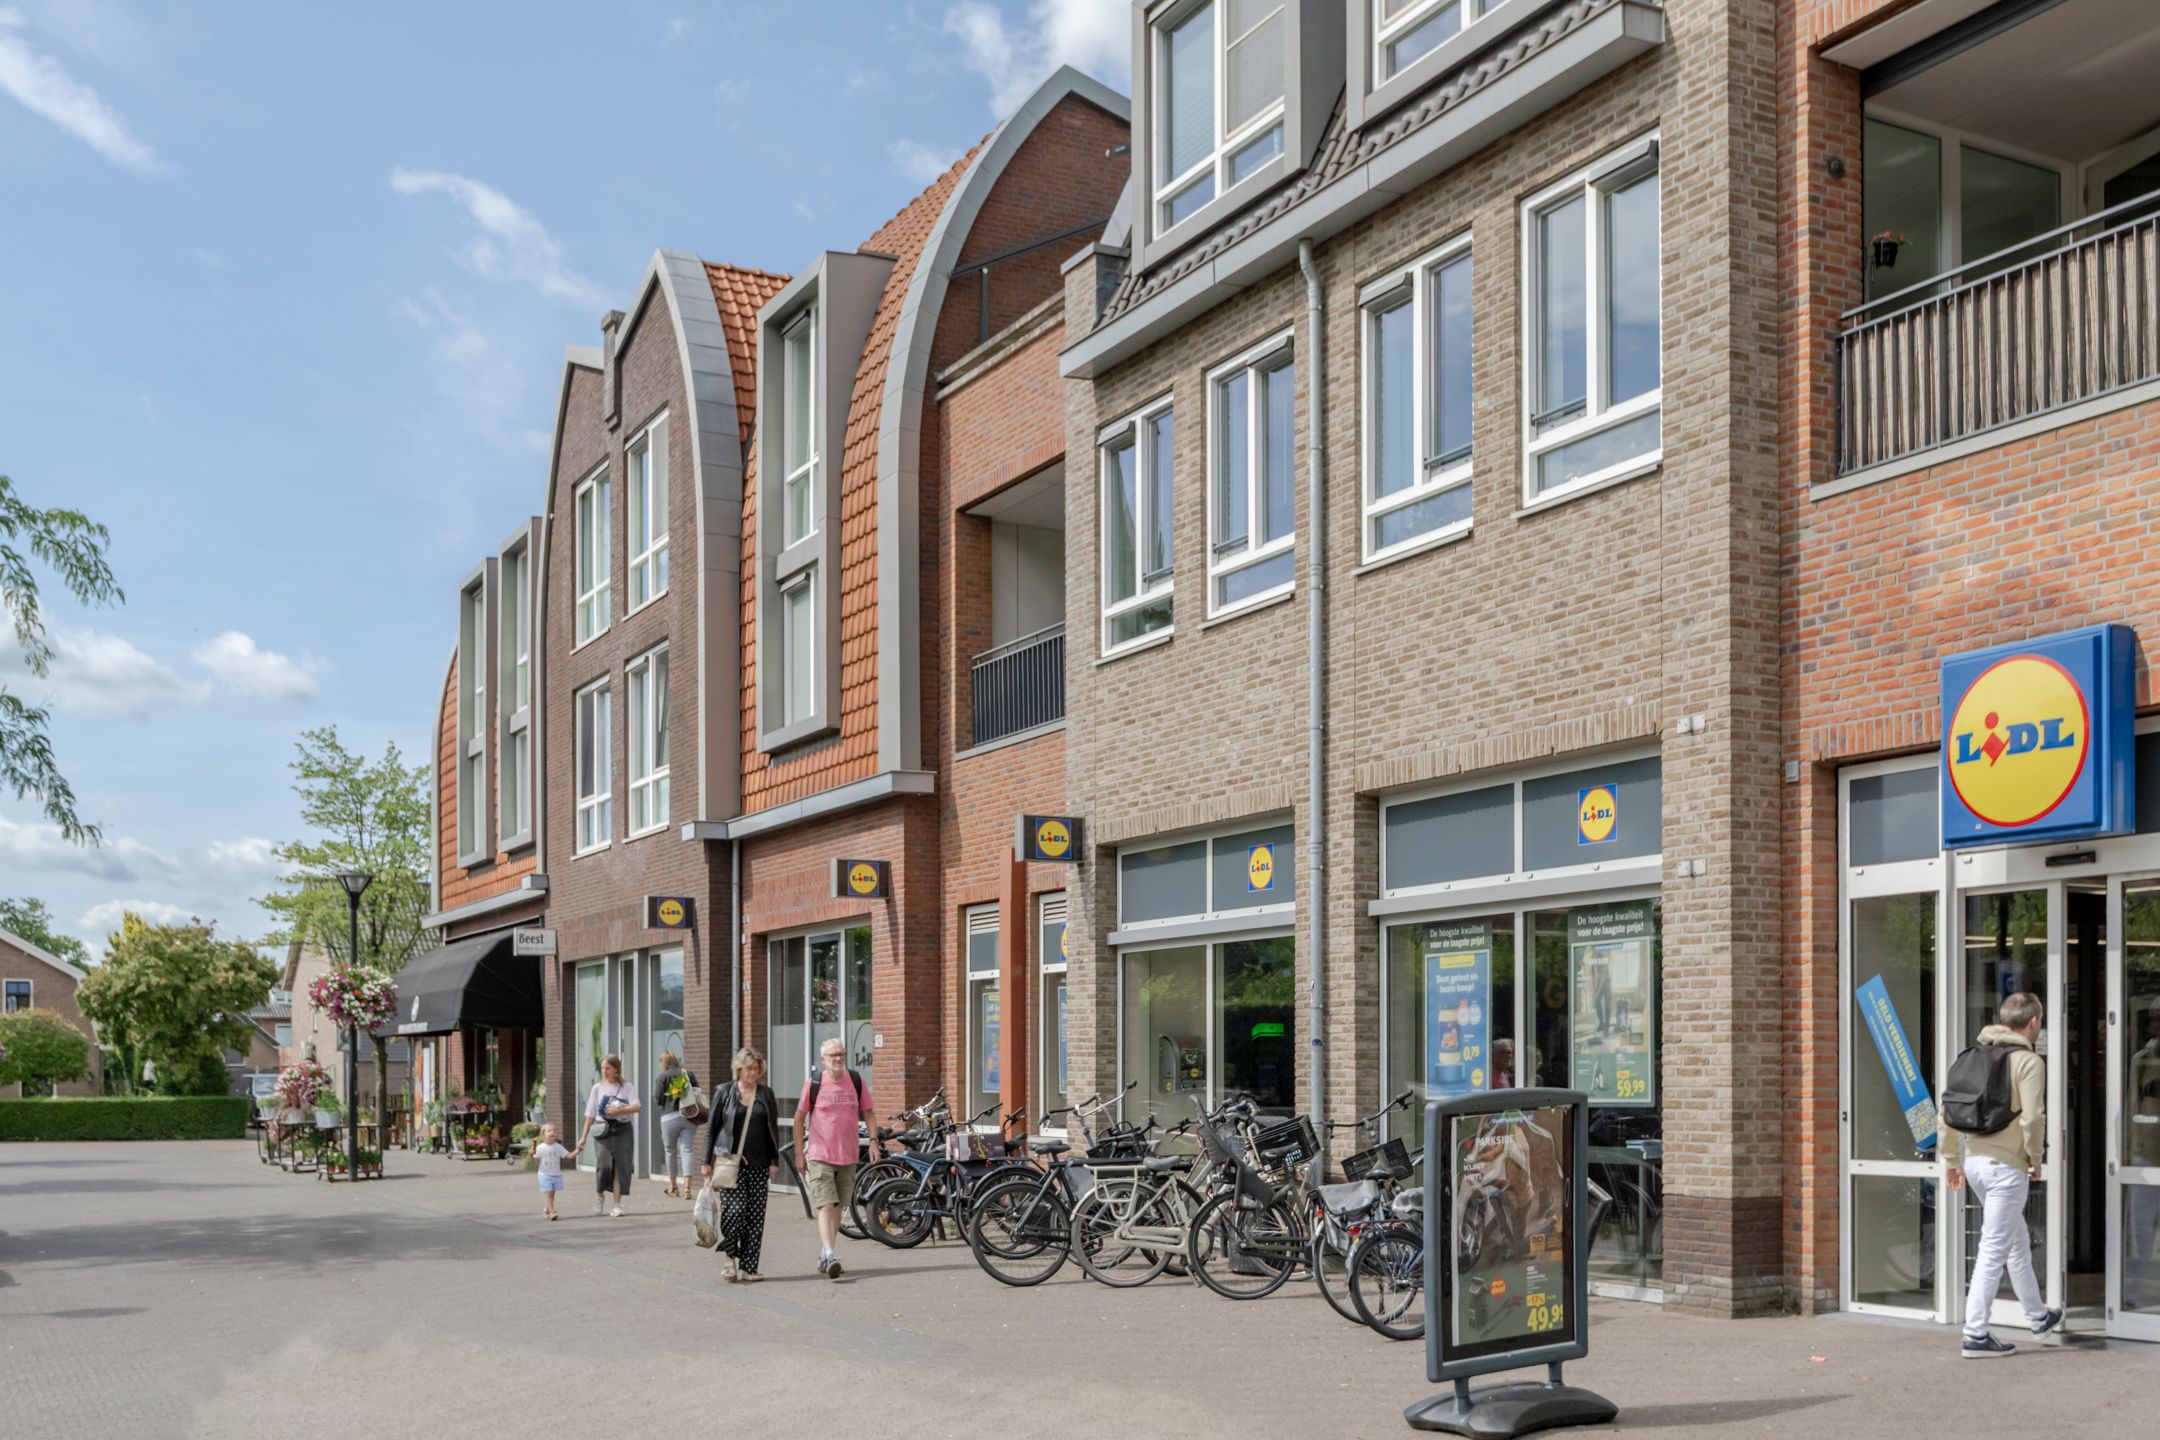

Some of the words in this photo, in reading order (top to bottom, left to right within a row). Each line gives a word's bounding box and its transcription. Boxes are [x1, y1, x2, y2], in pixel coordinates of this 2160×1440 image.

[1577, 916, 1586, 926] De
[1588, 914, 1614, 924] hoogste
[1614, 910, 1643, 920] kwaliteit
[1430, 930, 1438, 938] De
[1438, 928, 1460, 938] hoogste
[1460, 925, 1484, 934] kwaliteit
[1577, 928, 1592, 936] voor
[1592, 926, 1601, 936] de
[1602, 924, 1626, 936] laagste
[1626, 921, 1644, 934] prijs!
[519, 933, 544, 944] Beest
[1442, 939, 1450, 948] de
[1450, 938, 1470, 948] laagste
[1616, 1080, 1645, 1097] 59.99
